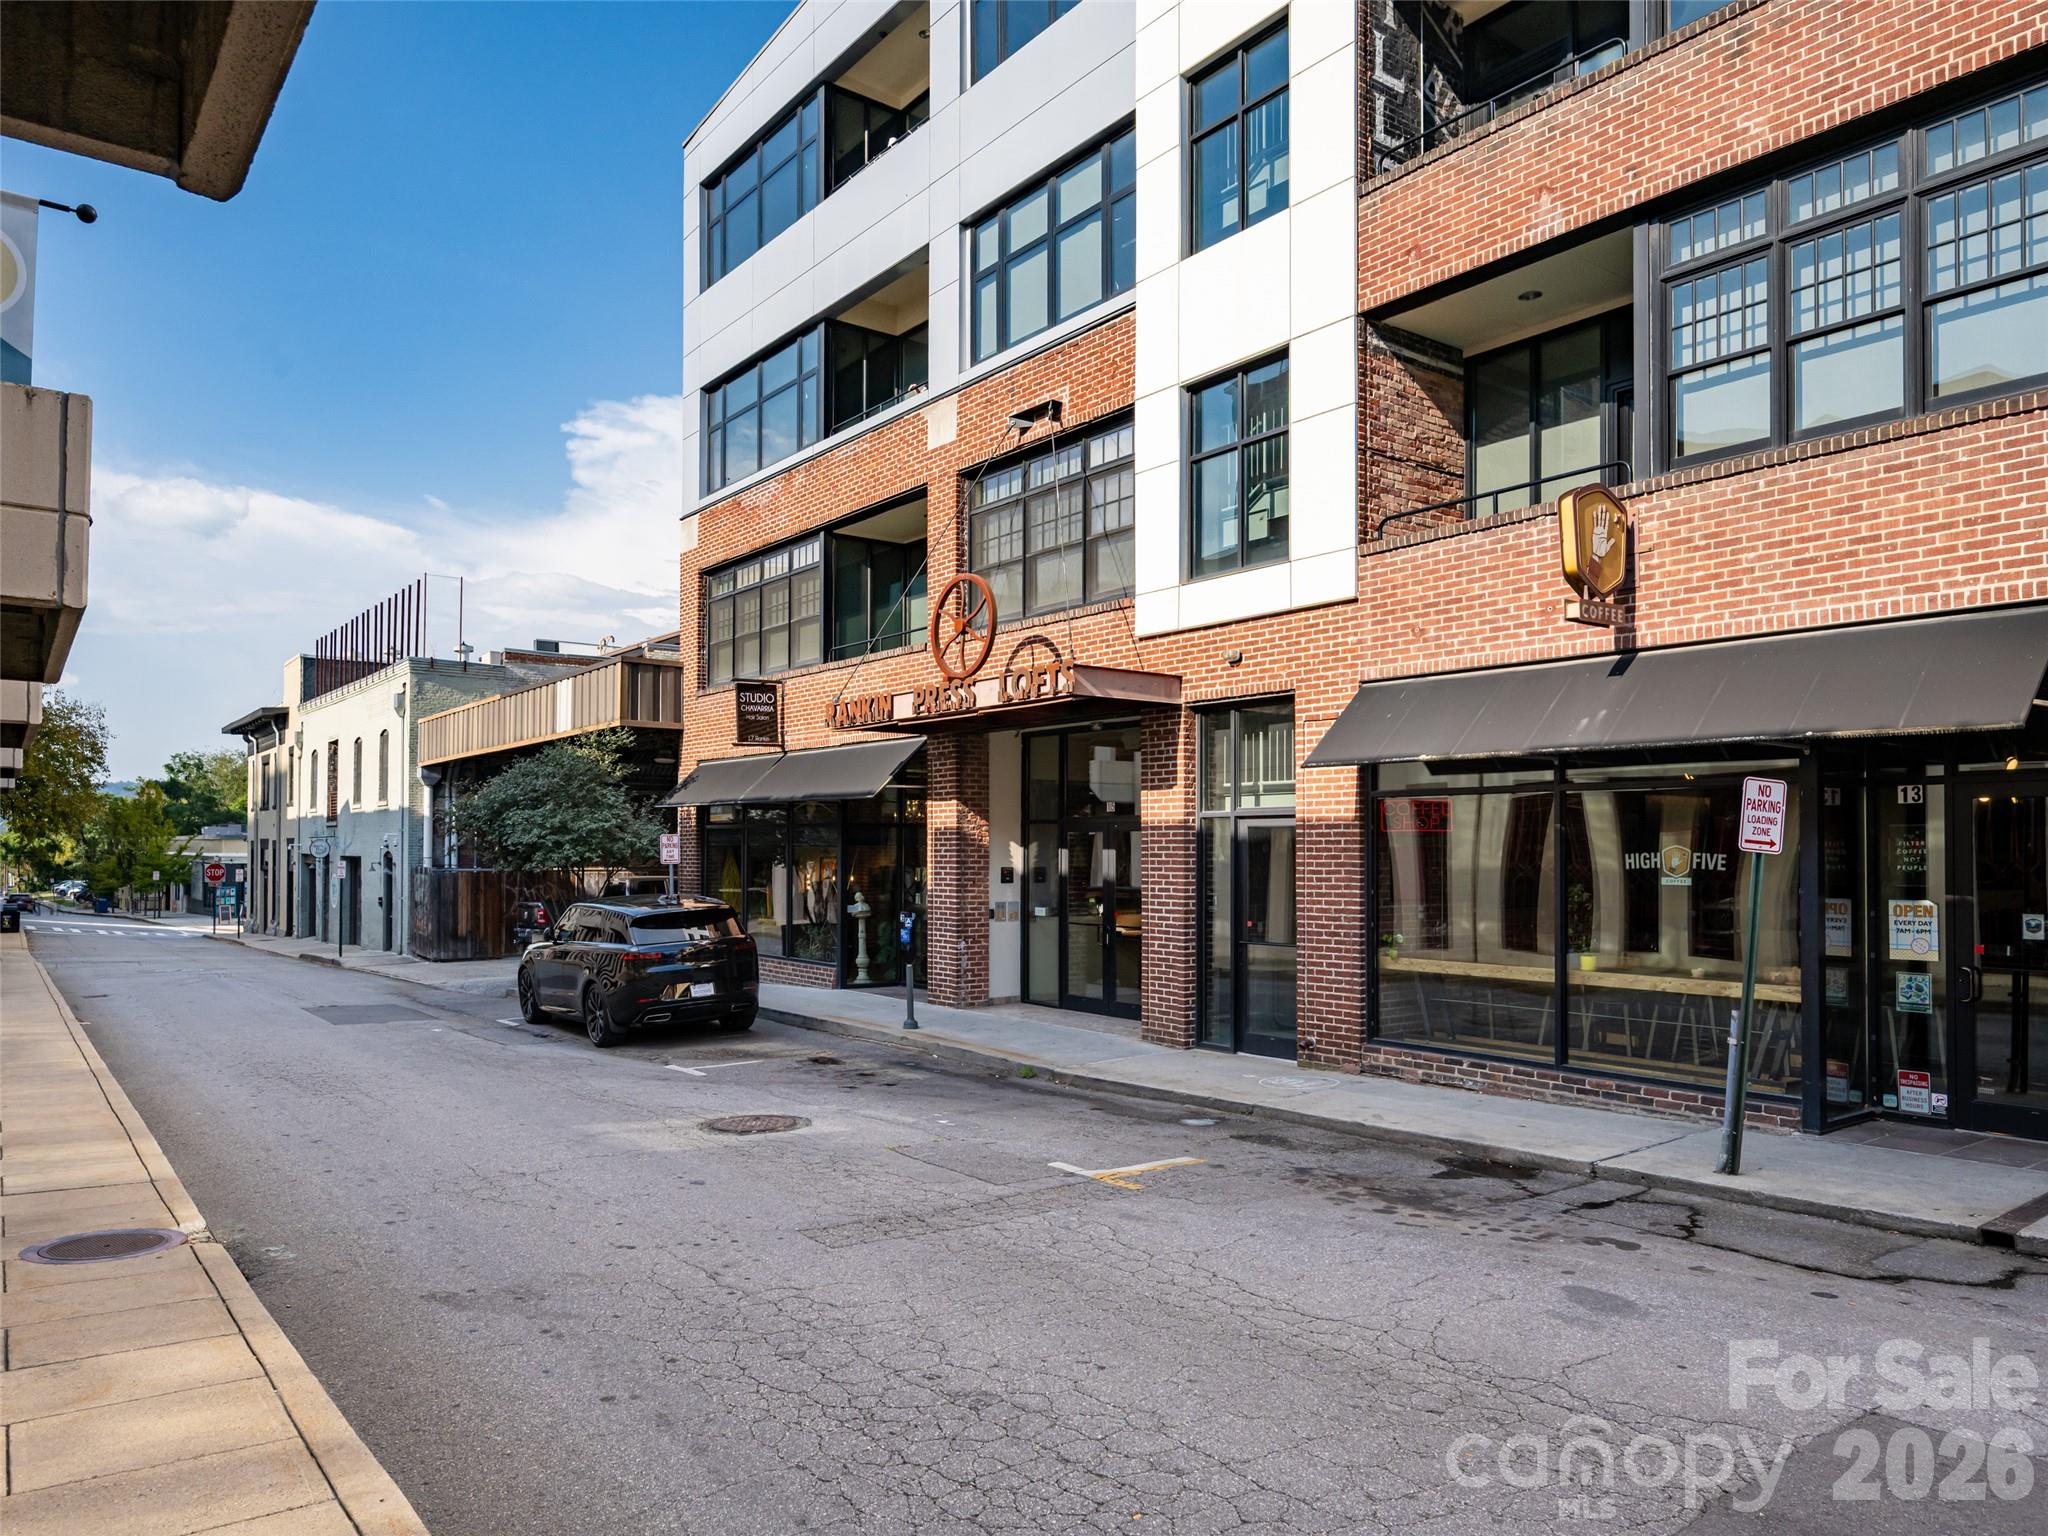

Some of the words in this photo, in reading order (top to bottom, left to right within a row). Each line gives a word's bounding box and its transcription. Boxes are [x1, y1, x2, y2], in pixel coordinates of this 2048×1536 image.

[1581, 604, 1624, 622] COFFEE
[740, 692, 775, 704] STUDIO
[825, 692, 893, 728] RANKIN
[912, 678, 976, 715] PRESS
[998, 658, 1075, 703] LOFTS
[740, 704, 775, 712] CHAVARRIA
[756, 713, 770, 721] Salon
[1757, 784, 1772, 798] NO
[1901, 786, 1921, 803] 13
[1384, 801, 1449, 816] COFFEE
[1746, 798, 1782, 814] PARKING
[1392, 816, 1440, 829] SHOP
[1747, 814, 1778, 826] LOADING
[1752, 827, 1772, 837] ZONE
[1625, 852, 1660, 870] HIGH
[1692, 852, 1728, 872] FIVE
[206, 868, 225, 877] STOP
[1892, 904, 1934, 918] OPEN
[1918, 920, 1933, 928] DAY
